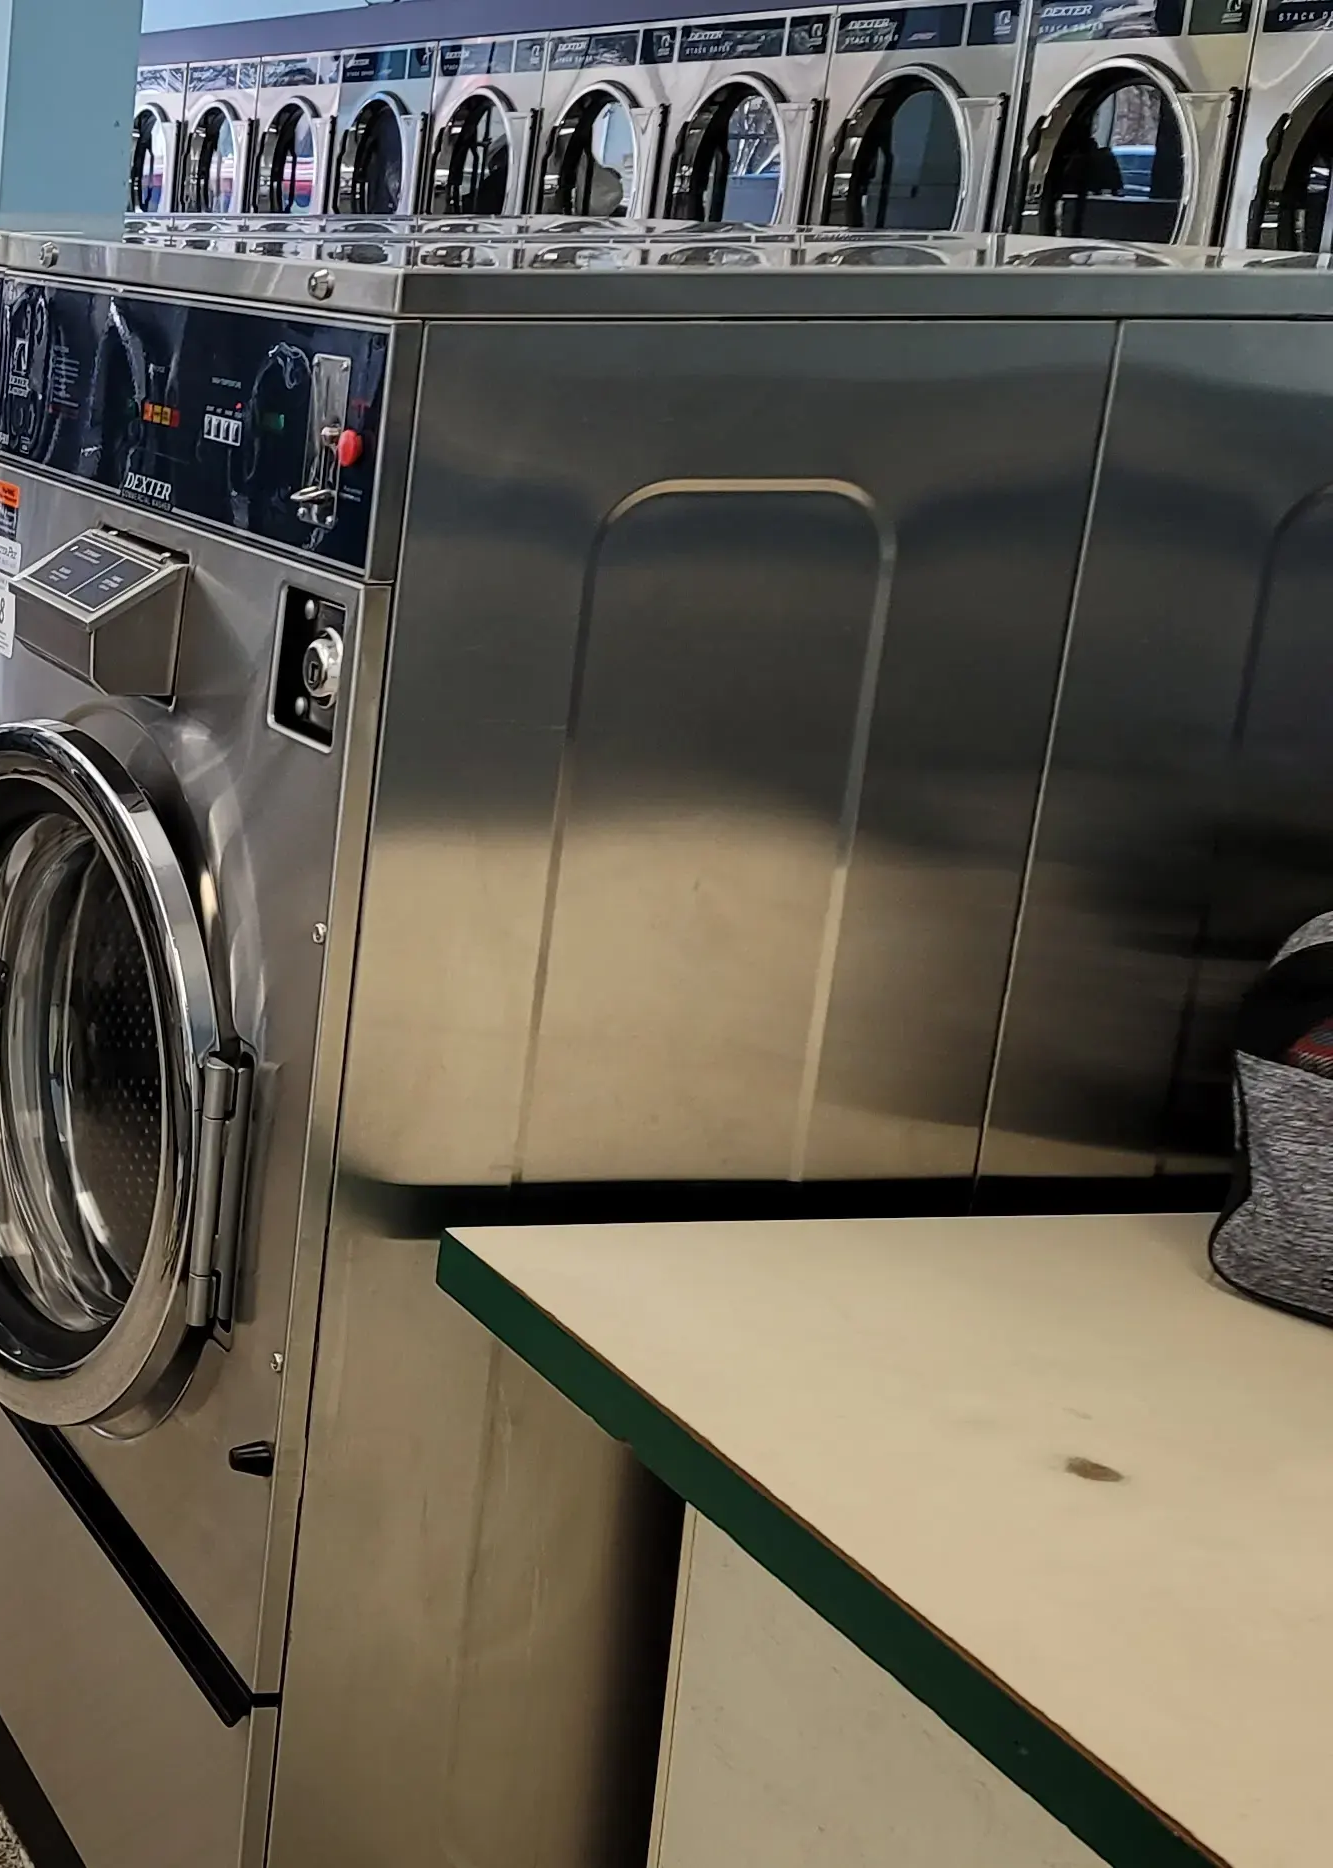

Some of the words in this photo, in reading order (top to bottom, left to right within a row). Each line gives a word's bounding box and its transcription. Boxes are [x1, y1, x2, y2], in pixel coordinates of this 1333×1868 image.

[1040, 5, 1093, 18] DEXTER
[1278, 12, 1315, 21] STACK
[124, 472, 172, 501] DEXTER
